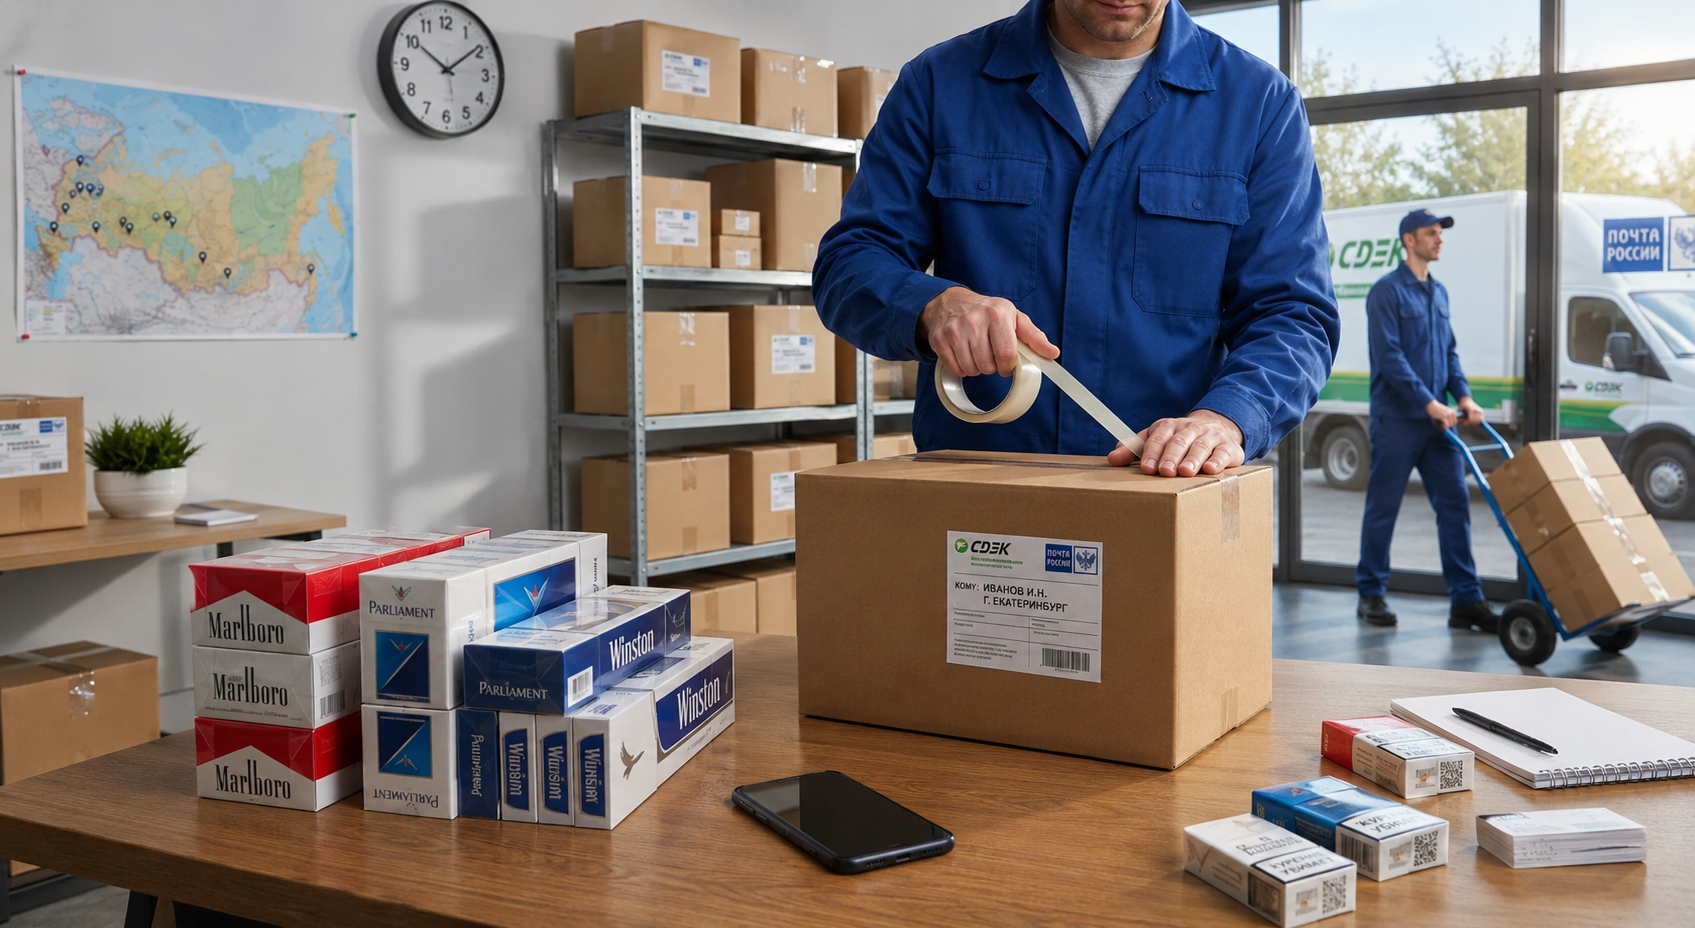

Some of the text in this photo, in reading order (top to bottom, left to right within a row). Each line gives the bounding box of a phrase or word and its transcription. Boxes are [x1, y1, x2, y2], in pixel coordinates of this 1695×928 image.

[421, 19, 431, 34] 11
[439, 16, 453, 30] 12
[463, 26, 468, 39] 1
[406, 35, 419, 49] 10
[475, 44, 484, 59] 2
[400, 57, 409, 71] 9
[481, 69, 490, 82] 3
[407, 82, 416, 96] 8
[475, 91, 484, 104] 4
[422, 101, 431, 115] 7
[462, 106, 470, 119] 5
[442, 110, 451, 124] 6
[1608, 228, 1660, 244] ПОЧТА
[1607, 246, 1660, 262] РОССИИ
[1047, 549, 1070, 558] ПОЧТА
[955, 582, 1047, 598] КОМУ: ИВАНОВ И.Н.
[369, 600, 435, 619] PARLIAMENT
[983, 596, 1068, 612] Г. ЕКАТЕРИНБУРГ
[208, 604, 284, 645] Marlboro
[609, 628, 654, 671] Winston
[212, 666, 288, 707] Marlboro
[479, 681, 548, 700] PARLIAMENT
[677, 676, 720, 730] Winston
[215, 759, 291, 800] Marlboro
